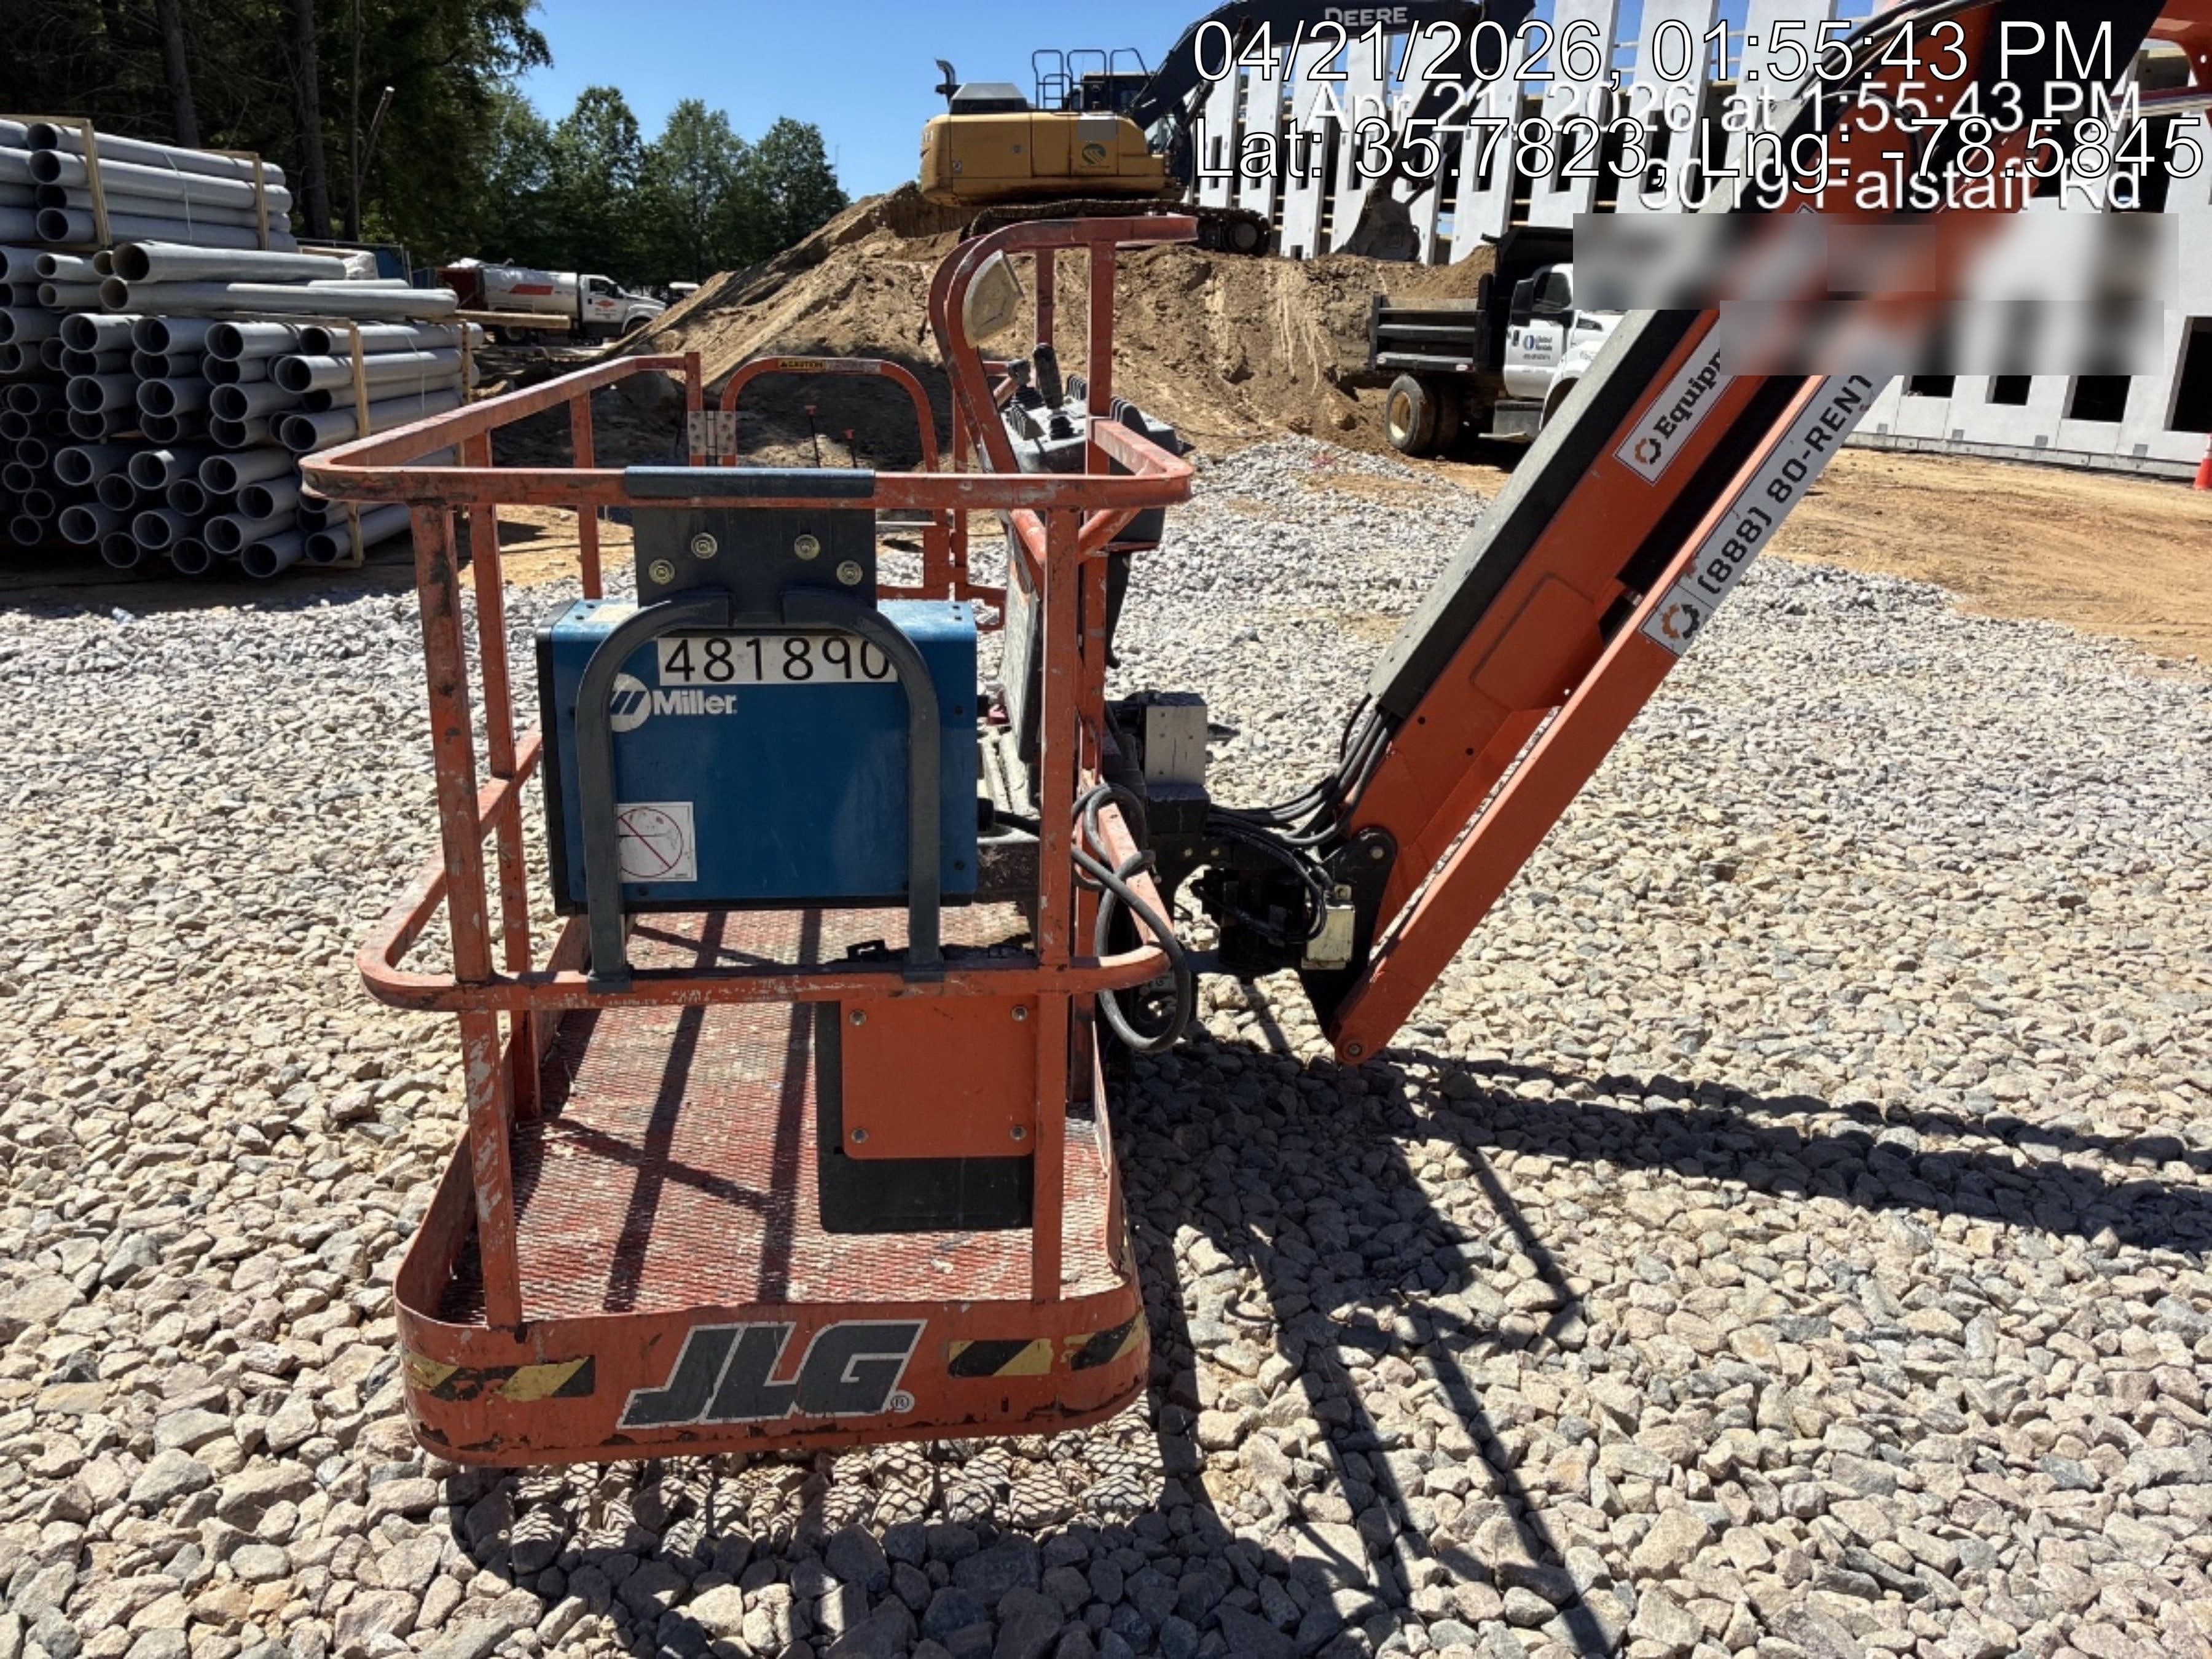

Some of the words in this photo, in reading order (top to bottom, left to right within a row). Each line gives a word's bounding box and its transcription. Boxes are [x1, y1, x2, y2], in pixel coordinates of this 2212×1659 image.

[1325, 7, 1408, 26] DEERE
[1698, 506, 1773, 594] (888)
[665, 637, 890, 682] 481890
[653, 689, 737, 715] Miller
